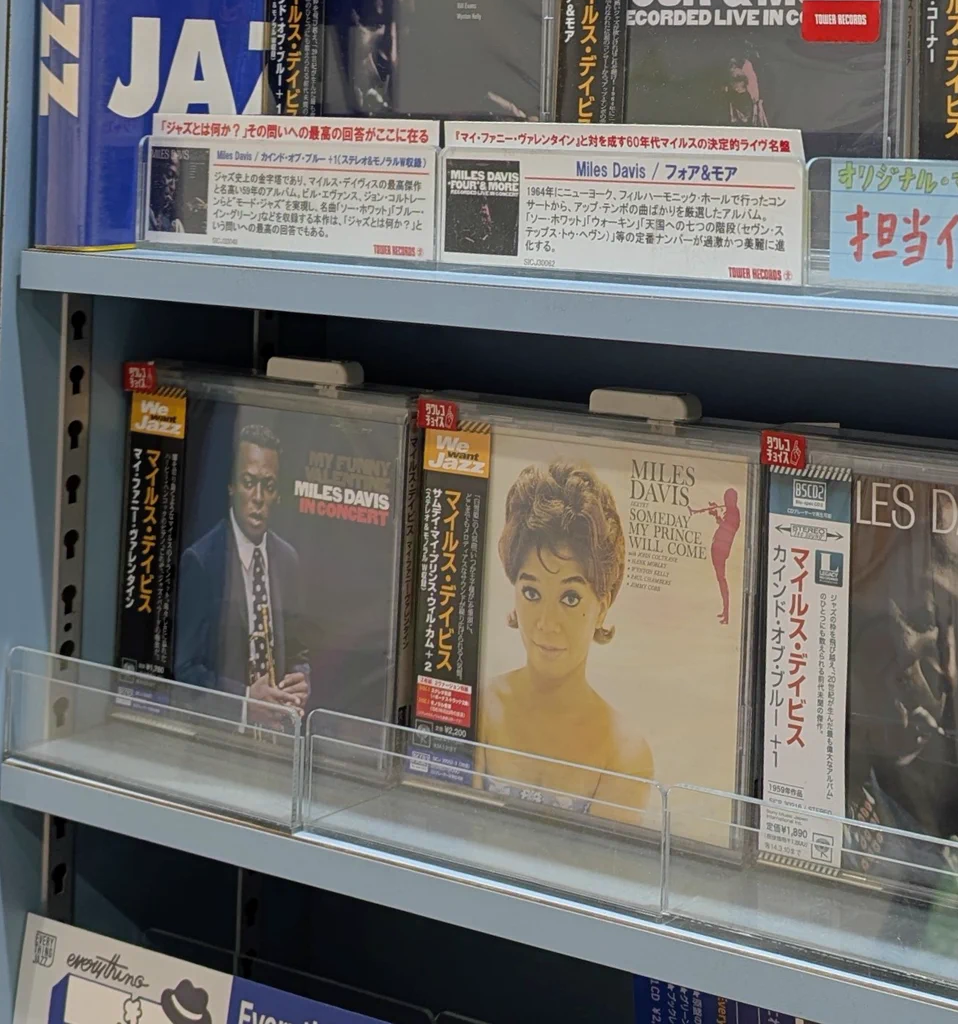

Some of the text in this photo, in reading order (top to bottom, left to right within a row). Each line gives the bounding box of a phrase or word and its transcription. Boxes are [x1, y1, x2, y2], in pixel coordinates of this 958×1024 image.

[714, 9, 761, 25] LIVE
[763, 9, 783, 25] IN
[814, 13, 836, 25] TOWER
[838, 14, 867, 26] RECORDS
[216, 150, 252, 161] Miles Davis
[450, 169, 519, 182] MILES DAVIS
[576, 161, 738, 183] Miles Davis フォア&モア
[488, 181, 519, 192] MORE
[525, 240, 556, 253] 化する。
[728, 266, 782, 281] TOWER RECORDS
[140, 400, 170, 415] We
[134, 416, 181, 435] Jazz
[436, 435, 470, 453] We
[308, 450, 391, 476] MY FUNNY
[428, 453, 486, 474] Jazz
[631, 459, 696, 487] MILES
[294, 480, 390, 511] MILES DAVIS
[630, 480, 690, 507] DAVIS
[299, 497, 390, 527] IN CONCERT
[856, 481, 915, 530] LES
[629, 508, 691, 528] SOMEDAY
[138, 449, 161, 613] マイルス・デイビス
[628, 522, 702, 545] MY PRINCE
[628, 536, 707, 560] WILL COME
[436, 490, 462, 672] マイルス・デイビス
[786, 548, 810, 748] マイルス・デイビス
[769, 783, 803, 798] 1959年作品
[35, 932, 54, 946] EVERY
